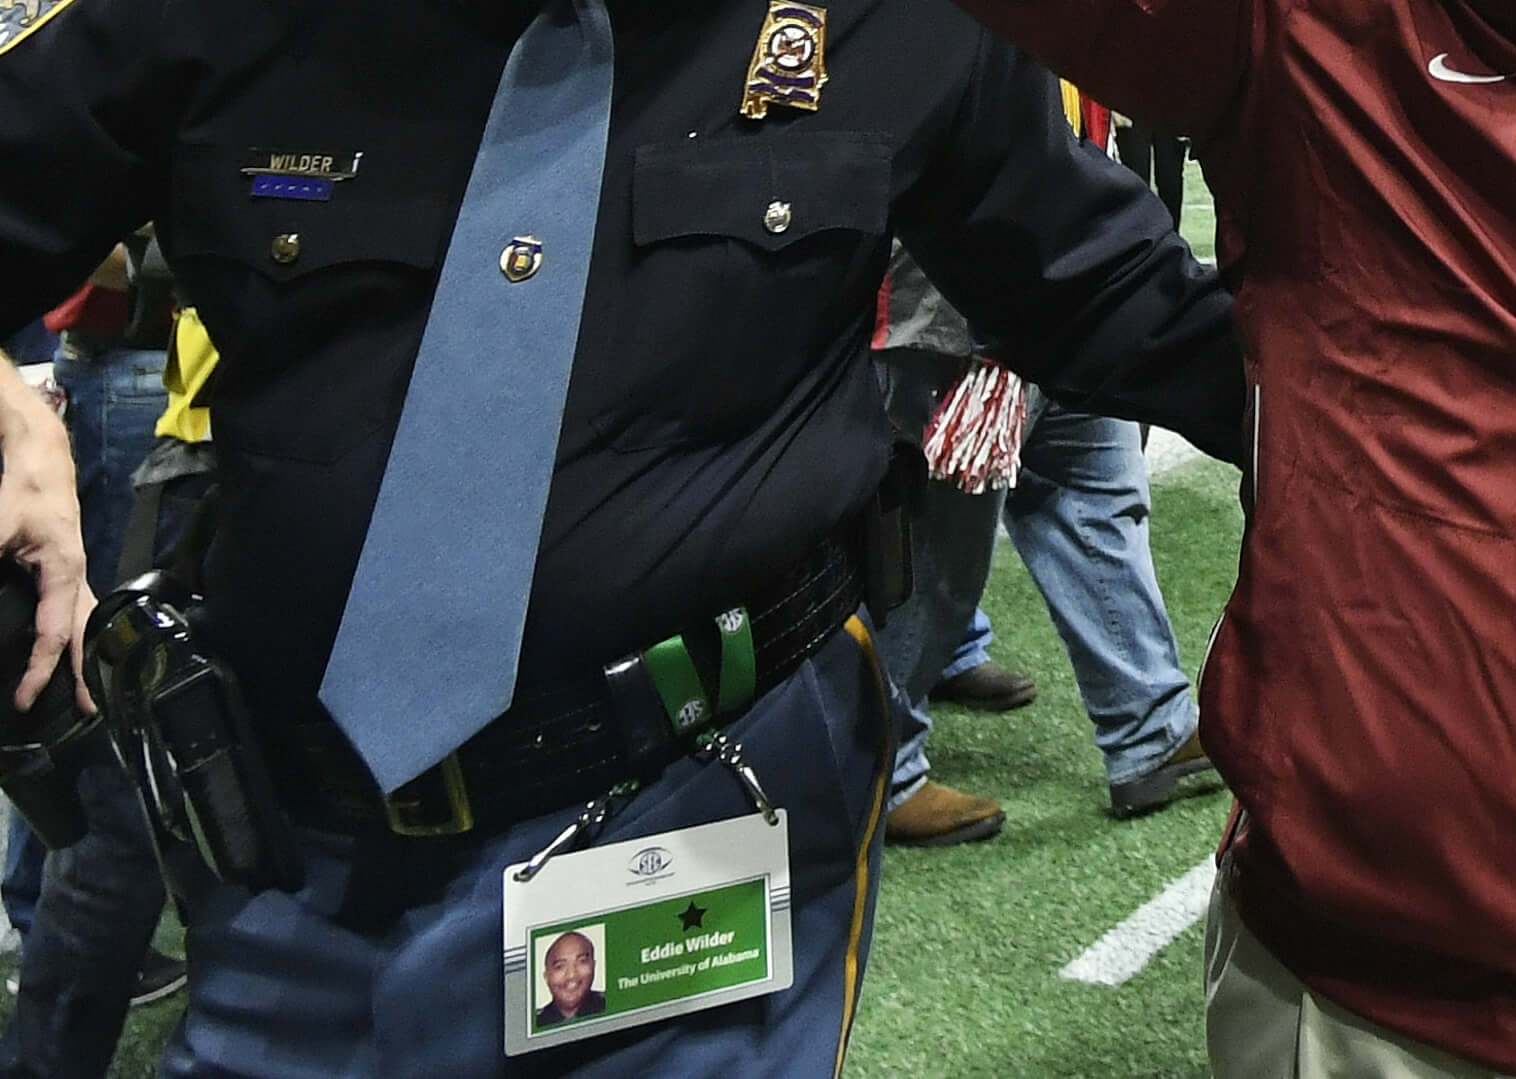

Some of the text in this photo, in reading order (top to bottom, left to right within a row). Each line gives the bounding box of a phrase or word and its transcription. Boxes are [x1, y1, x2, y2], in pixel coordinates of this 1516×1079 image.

[269, 153, 335, 174] WILDER
[640, 930, 736, 964] Eddie Wilder
[617, 948, 760, 991] The University of Alabama
